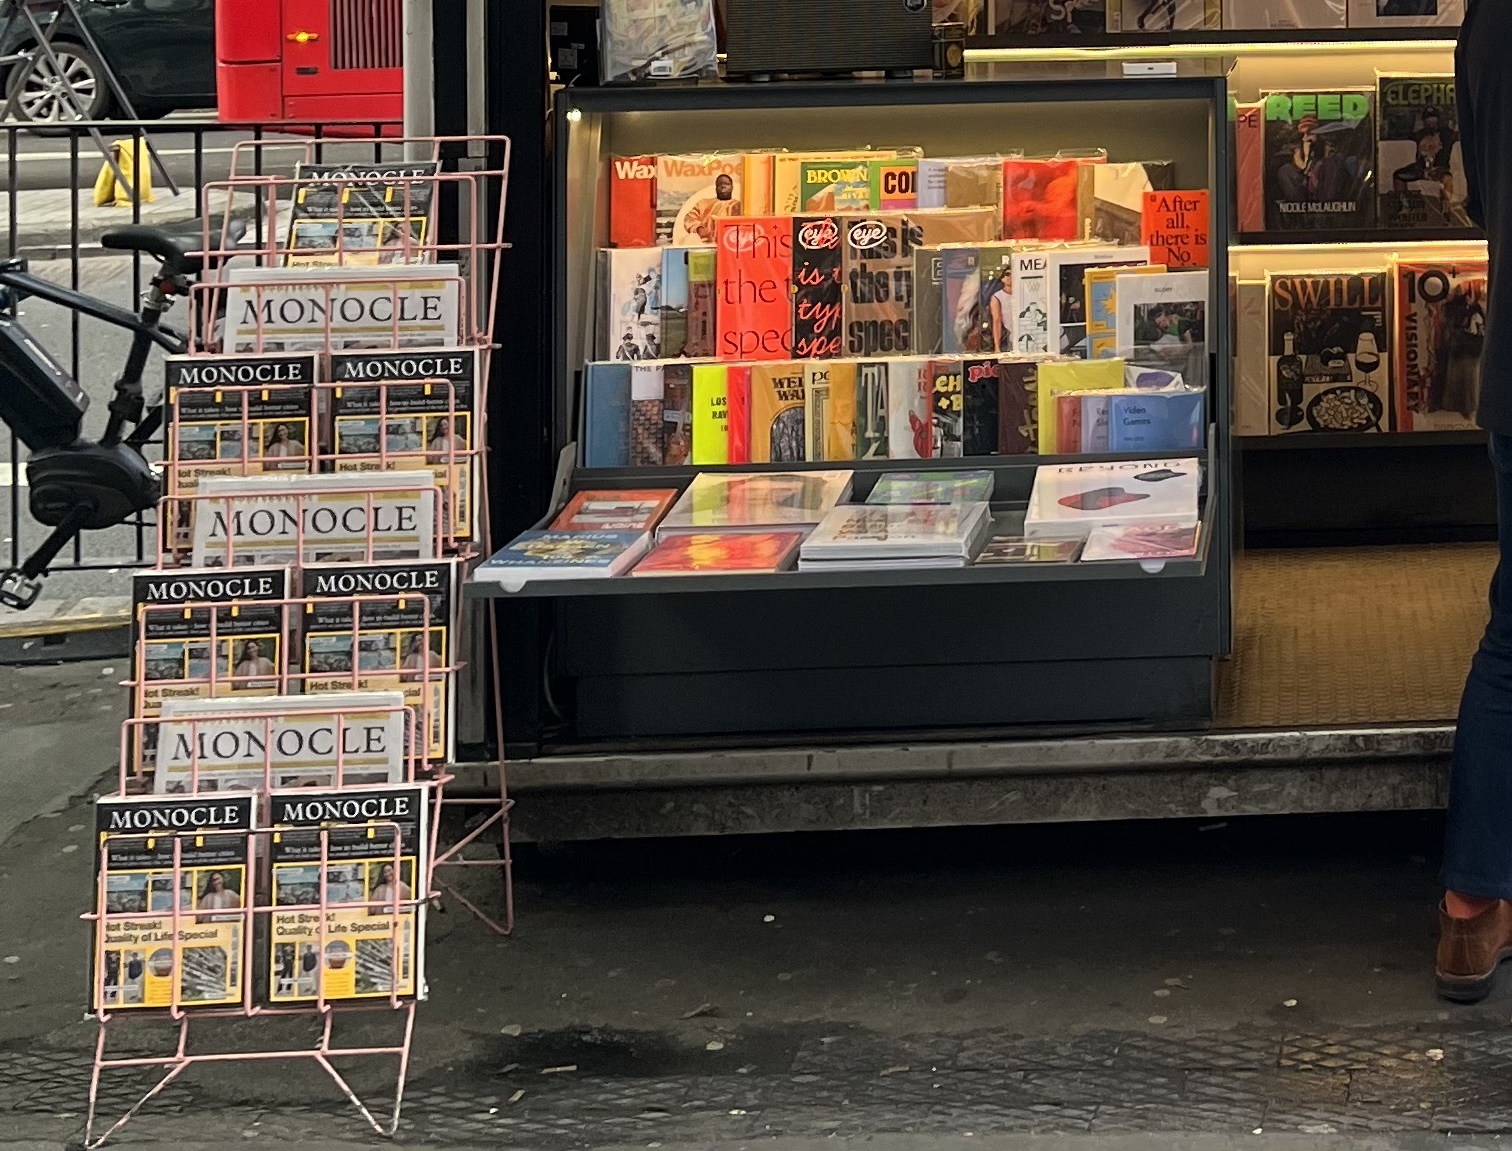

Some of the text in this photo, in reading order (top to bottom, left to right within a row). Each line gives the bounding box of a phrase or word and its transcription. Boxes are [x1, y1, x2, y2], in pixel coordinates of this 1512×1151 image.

[309, 169, 426, 187] MONOCLE
[1156, 194, 1200, 212] After
[1149, 228, 1207, 247] there is
[1167, 247, 1191, 263] No
[798, 261, 825, 286] is
[723, 268, 777, 305] the
[1274, 276, 1383, 312] SWILL
[239, 295, 442, 325] MONOCLE
[178, 363, 302, 384] MONOCLE
[344, 357, 462, 378] MONOCLE
[1123, 406, 1147, 414] Video
[208, 504, 417, 537] MONOCLE
[146, 577, 273, 600] MONOCLE
[316, 570, 440, 593] MONOCLE
[171, 725, 387, 760] MONOCLE
[109, 805, 240, 830] MONOCLE
[283, 797, 410, 822] MONOCLE
[123, 919, 163, 931] Streak!
[276, 911, 336, 923] Hot Strek!
[141, 931, 152, 943] of
[153, 929, 174, 941] Life
[177, 928, 219, 941] Special
[276, 921, 391, 937] Quality Life Special
